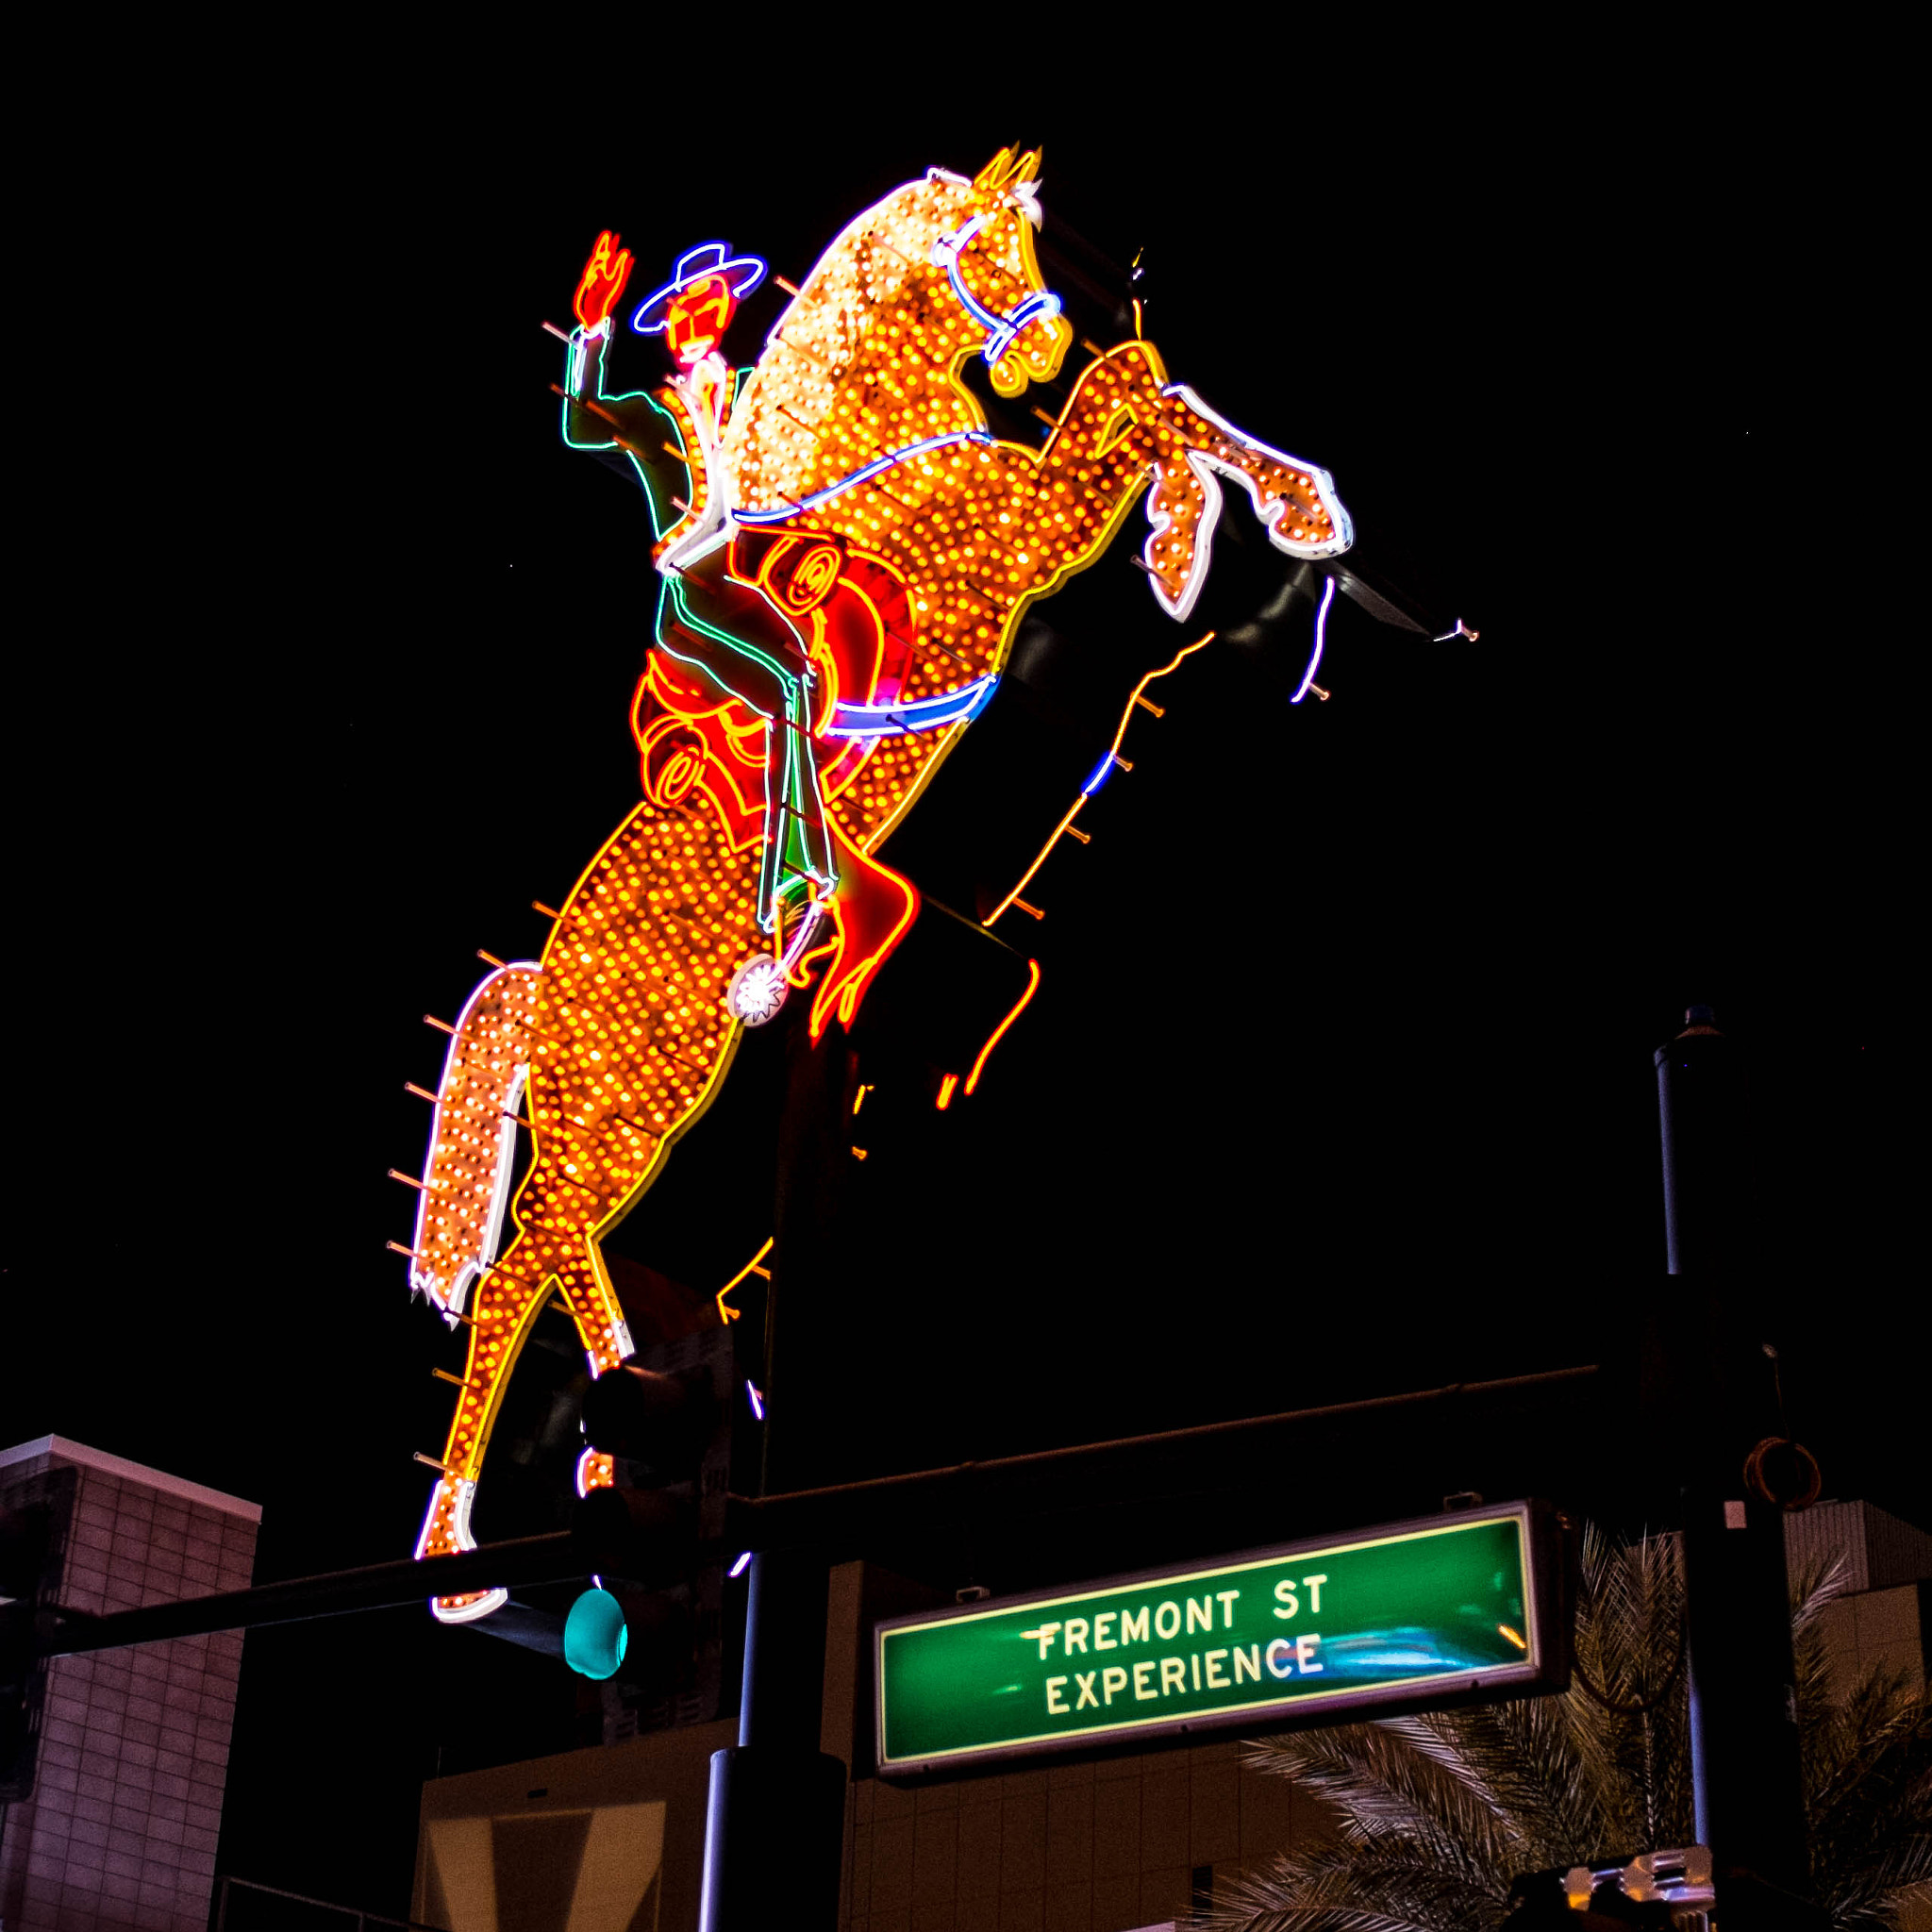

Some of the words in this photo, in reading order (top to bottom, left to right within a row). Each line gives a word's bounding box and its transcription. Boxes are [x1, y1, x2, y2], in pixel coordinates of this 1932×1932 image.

[1039, 1591, 1240, 1660] FREMONT
[1274, 1574, 1328, 1620] ST
[1045, 1634, 1324, 1715] EXPERIENCE
